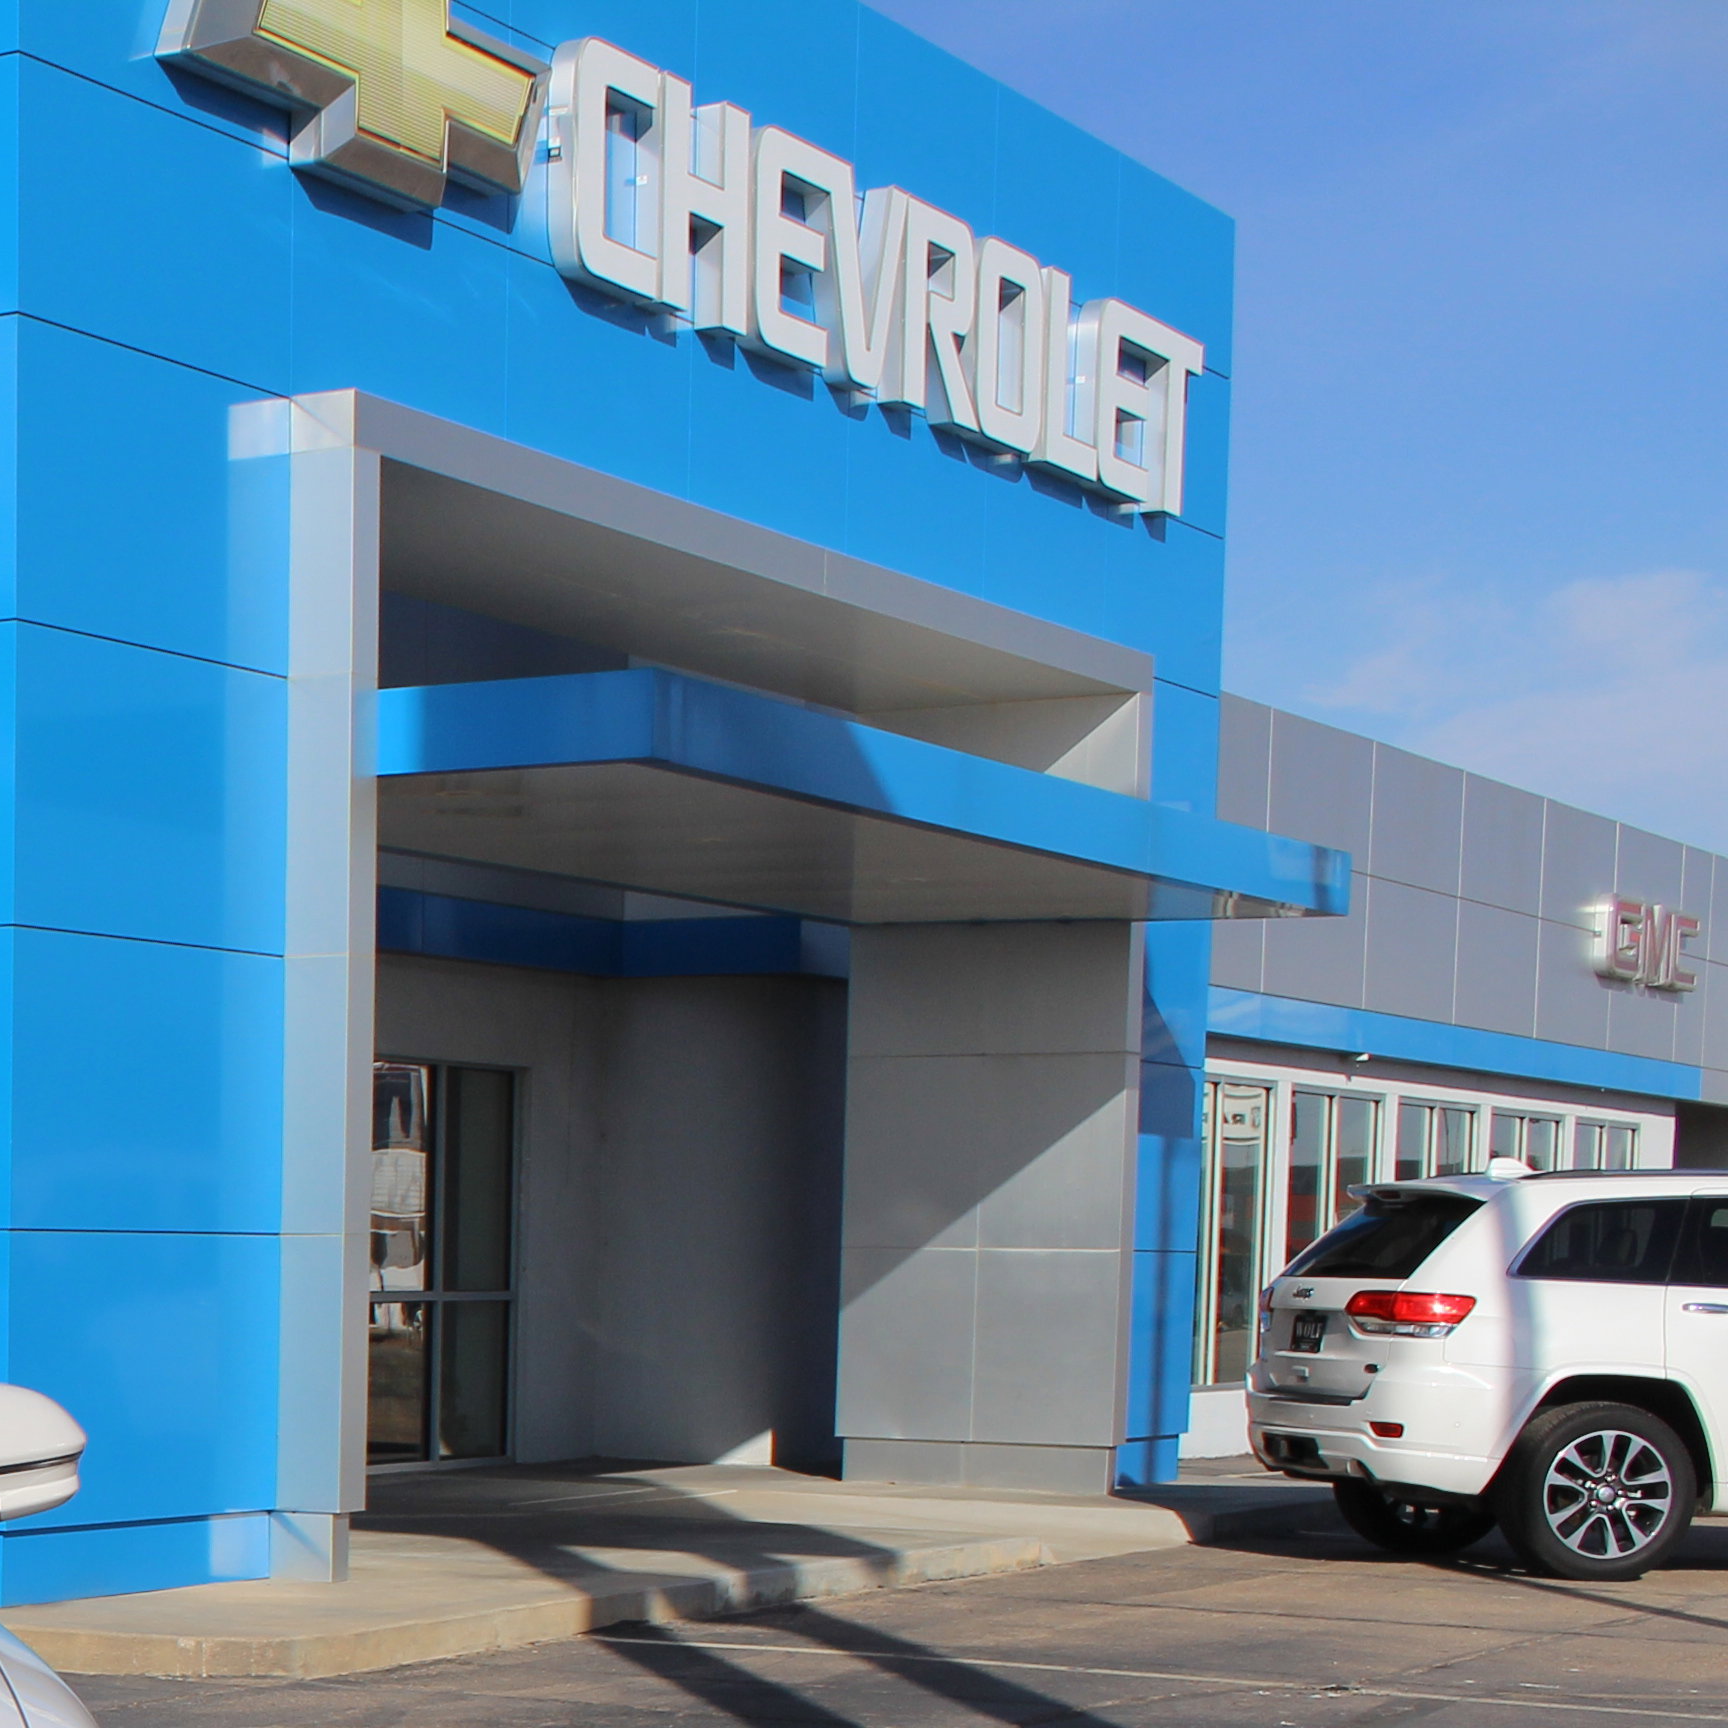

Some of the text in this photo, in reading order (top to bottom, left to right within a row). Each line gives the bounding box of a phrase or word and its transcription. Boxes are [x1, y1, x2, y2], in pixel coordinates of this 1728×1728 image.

[548, 36, 1204, 517] CHEVROLET
[1596, 894, 1700, 991] GMC
[1296, 1321, 1323, 1338] WOLF
